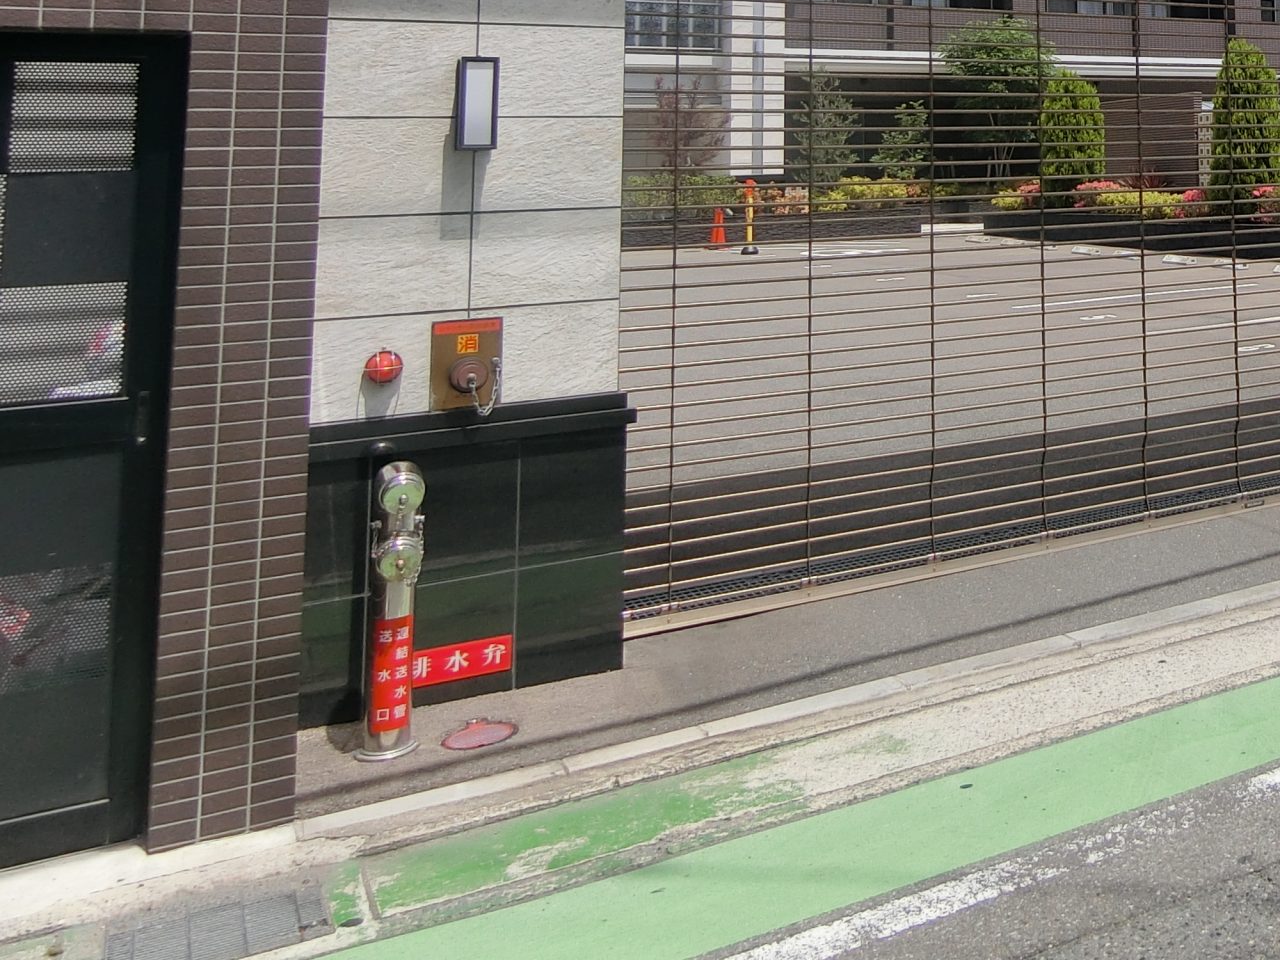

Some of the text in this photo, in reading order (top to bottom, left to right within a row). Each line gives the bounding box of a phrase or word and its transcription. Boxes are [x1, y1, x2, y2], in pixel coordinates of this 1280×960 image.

[458, 335, 478, 353] 消
[376, 630, 393, 721] 送水口
